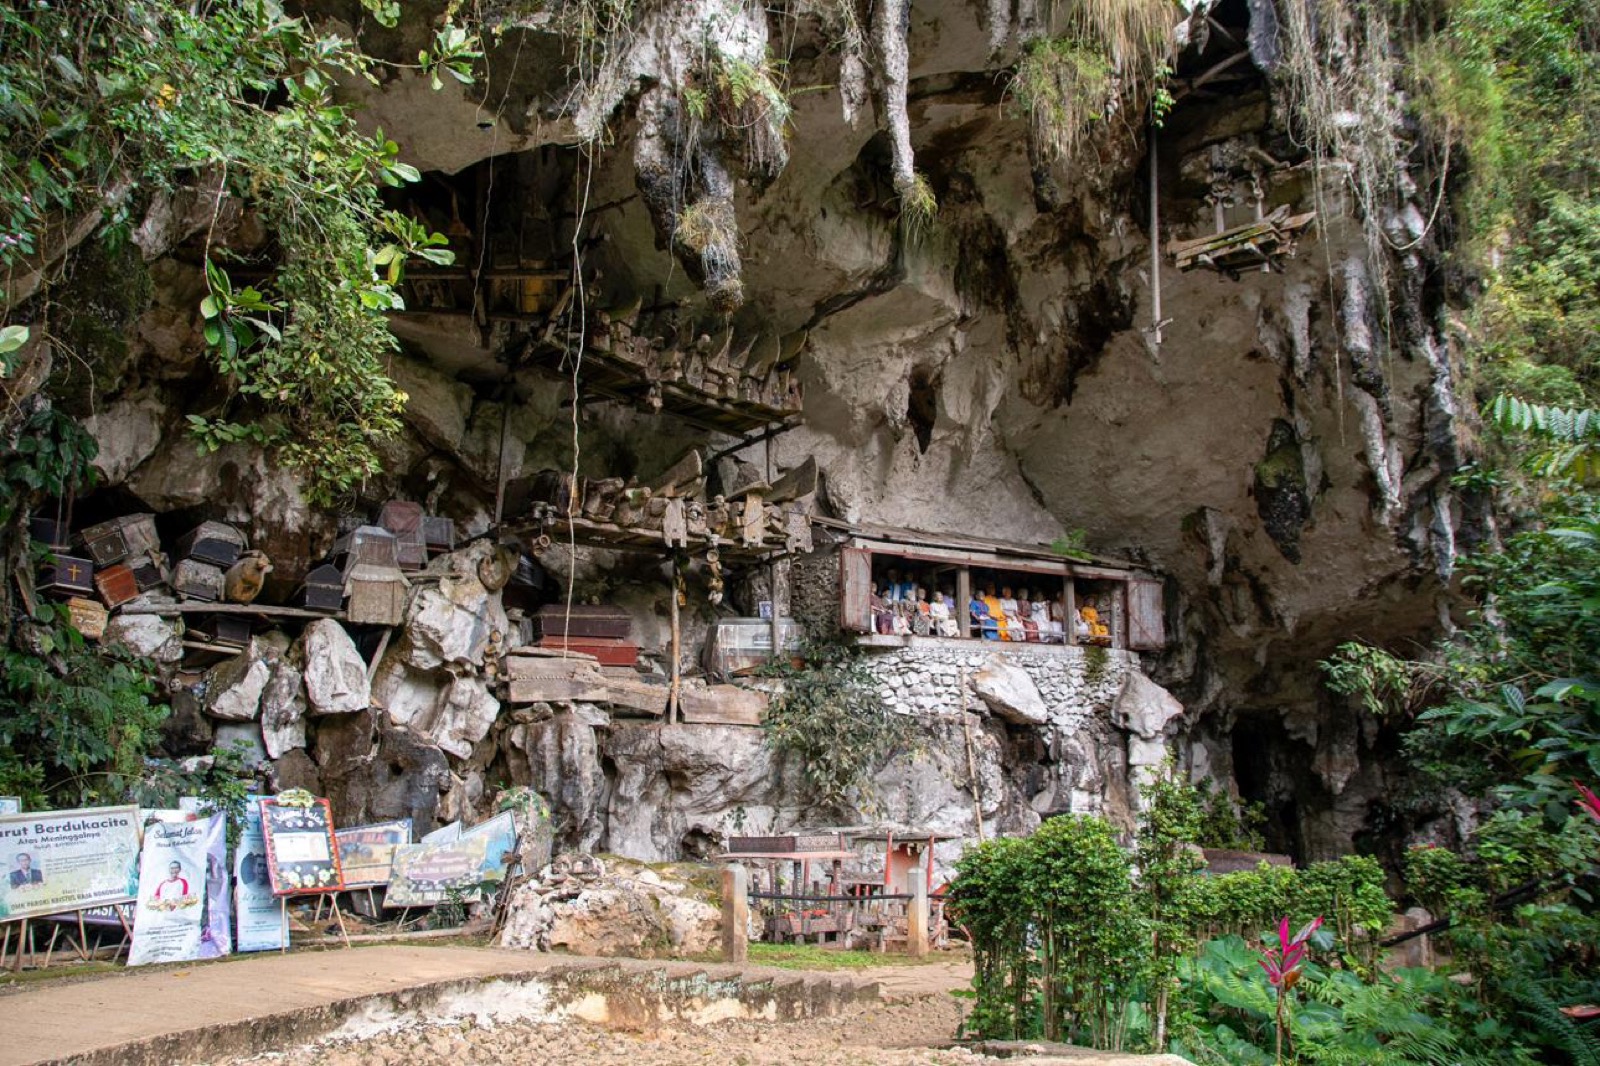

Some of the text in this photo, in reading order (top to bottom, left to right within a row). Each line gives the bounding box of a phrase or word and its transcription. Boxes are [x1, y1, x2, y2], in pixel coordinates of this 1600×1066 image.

[34, 817, 129, 834] Berdukacita
[17, 837, 38, 845] Atas
[41, 832, 101, 843] Meninggalnya
